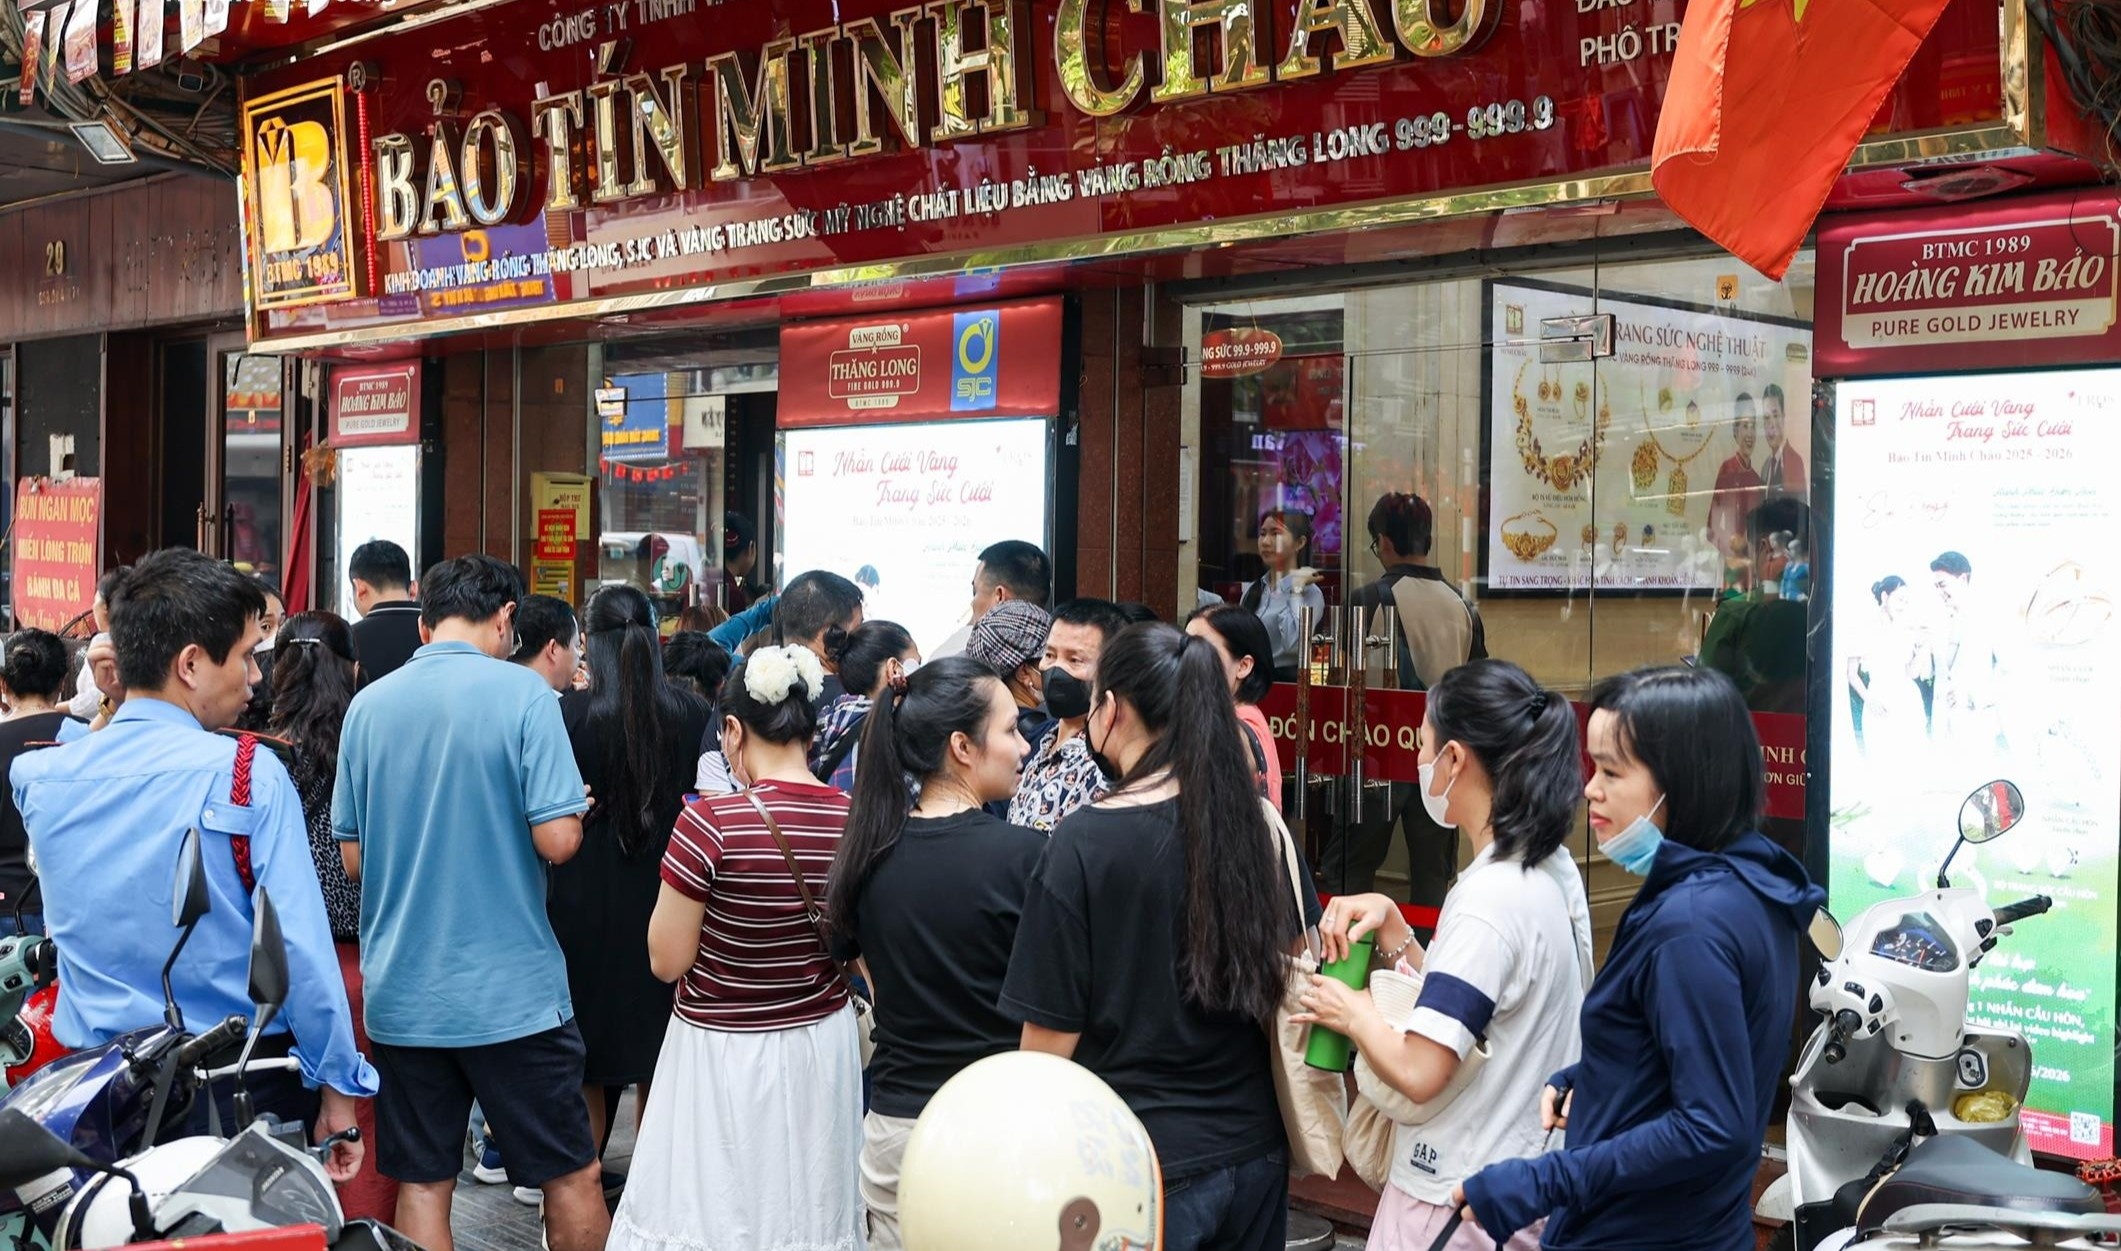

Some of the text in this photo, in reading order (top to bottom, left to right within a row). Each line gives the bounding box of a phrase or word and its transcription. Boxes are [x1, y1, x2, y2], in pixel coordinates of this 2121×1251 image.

[538, 9, 596, 51] CÔNG
[372, 78, 517, 242] BẢO
[532, 40, 688, 212] TÍN
[706, 0, 1030, 182] MINH
[385, 272, 410, 294] KINH
[412, 267, 455, 292] DOANH
[456, 256, 489, 286] VÀNG
[531, 245, 578, 275] THĂNG
[580, 240, 624, 270] LONG,
[626, 235, 652, 264] SJC
[656, 227, 680, 259] VÀ
[679, 222, 725, 256] VÀNG
[725, 216, 783, 249] TRANG
[783, 206, 820, 242] SỨC
[823, 202, 851, 235] MỸ
[854, 192, 905, 232] NGHỆ
[908, 181, 961, 222] CHẤT
[964, 177, 1009, 219] LIỆU
[1012, 165, 1073, 208] BẰNG
[1077, 156, 1140, 198] VÀNG
[1143, 145, 1211, 188] RỒNG
[1216, 132, 1308, 177] THĂNG
[1312, 122, 1390, 164] LONG
[46, 240, 65, 277] 29
[1922, 234, 2031, 260] BTMC 1989
[306, 252, 341, 278] 1989
[1852, 245, 2105, 305] HOÀNG KIM BẢO
[852, 328, 875, 343] VÀNG
[1872, 308, 2080, 338] PURE GOLD JEWELRY
[1215, 343, 1232, 358] SỨC
[1656, 323, 1683, 348] SỨC
[1686, 330, 1723, 358] NGHỆ
[1726, 335, 1767, 363] THUẬT
[831, 357, 917, 380] THĂNG LONG
[1619, 352, 1640, 364] VÀNG
[1687, 360, 1707, 372] LONG
[847, 381, 862, 392] FINE
[1950, 399, 1986, 418] Cưới
[1946, 419, 2073, 444] Trang Sức Cưới
[876, 480, 919, 511] Trang
[38, 496, 68, 522] NGAN
[70, 496, 94, 527] MỌC
[67, 537, 92, 570] TRỘN
[67, 576, 81, 602] CÁ
[1510, 575, 1521, 585] TIN
[1521, 575, 1540, 585] SANG
[2024, 1024, 2050, 1037] video
[2051, 1026, 2095, 1045] highlight
[1413, 1142, 1437, 1164] GAP
